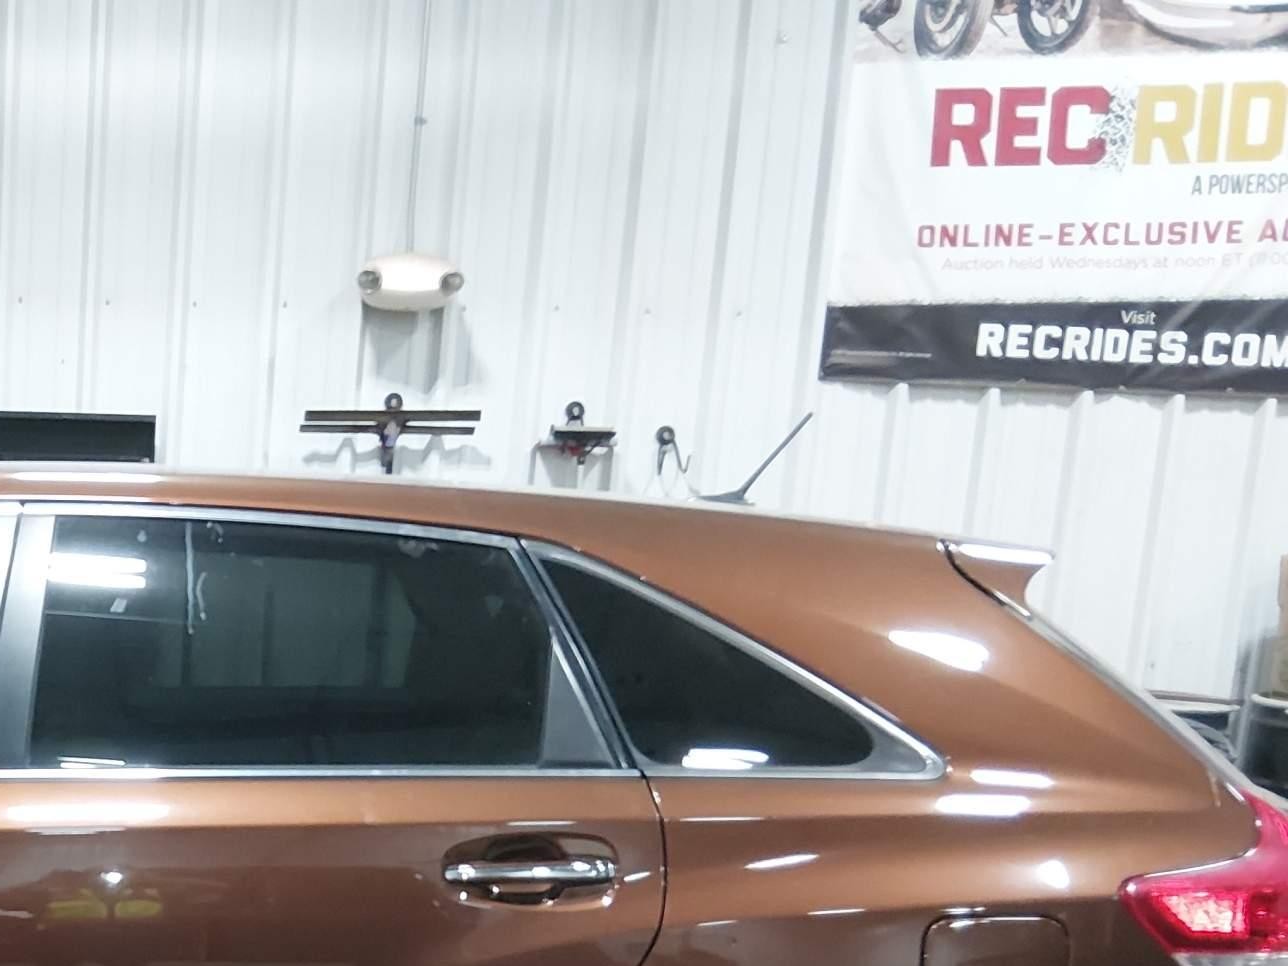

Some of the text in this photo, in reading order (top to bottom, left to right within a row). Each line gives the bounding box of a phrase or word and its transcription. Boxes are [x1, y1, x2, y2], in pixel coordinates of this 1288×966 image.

[1191, 175, 1202, 196] A
[918, 221, 1243, 248] ONLINE-EXCLUSIVE
[941, 257, 1004, 271] Auction
[1008, 256, 1043, 271] held
[1049, 255, 1148, 272] Wednesdays
[1153, 256, 1168, 269] at
[1176, 257, 1215, 267] noon
[1222, 252, 1244, 267] ET
[1121, 310, 1156, 325] Visit
[976, 323, 1288, 368] RECRIDES.COM
